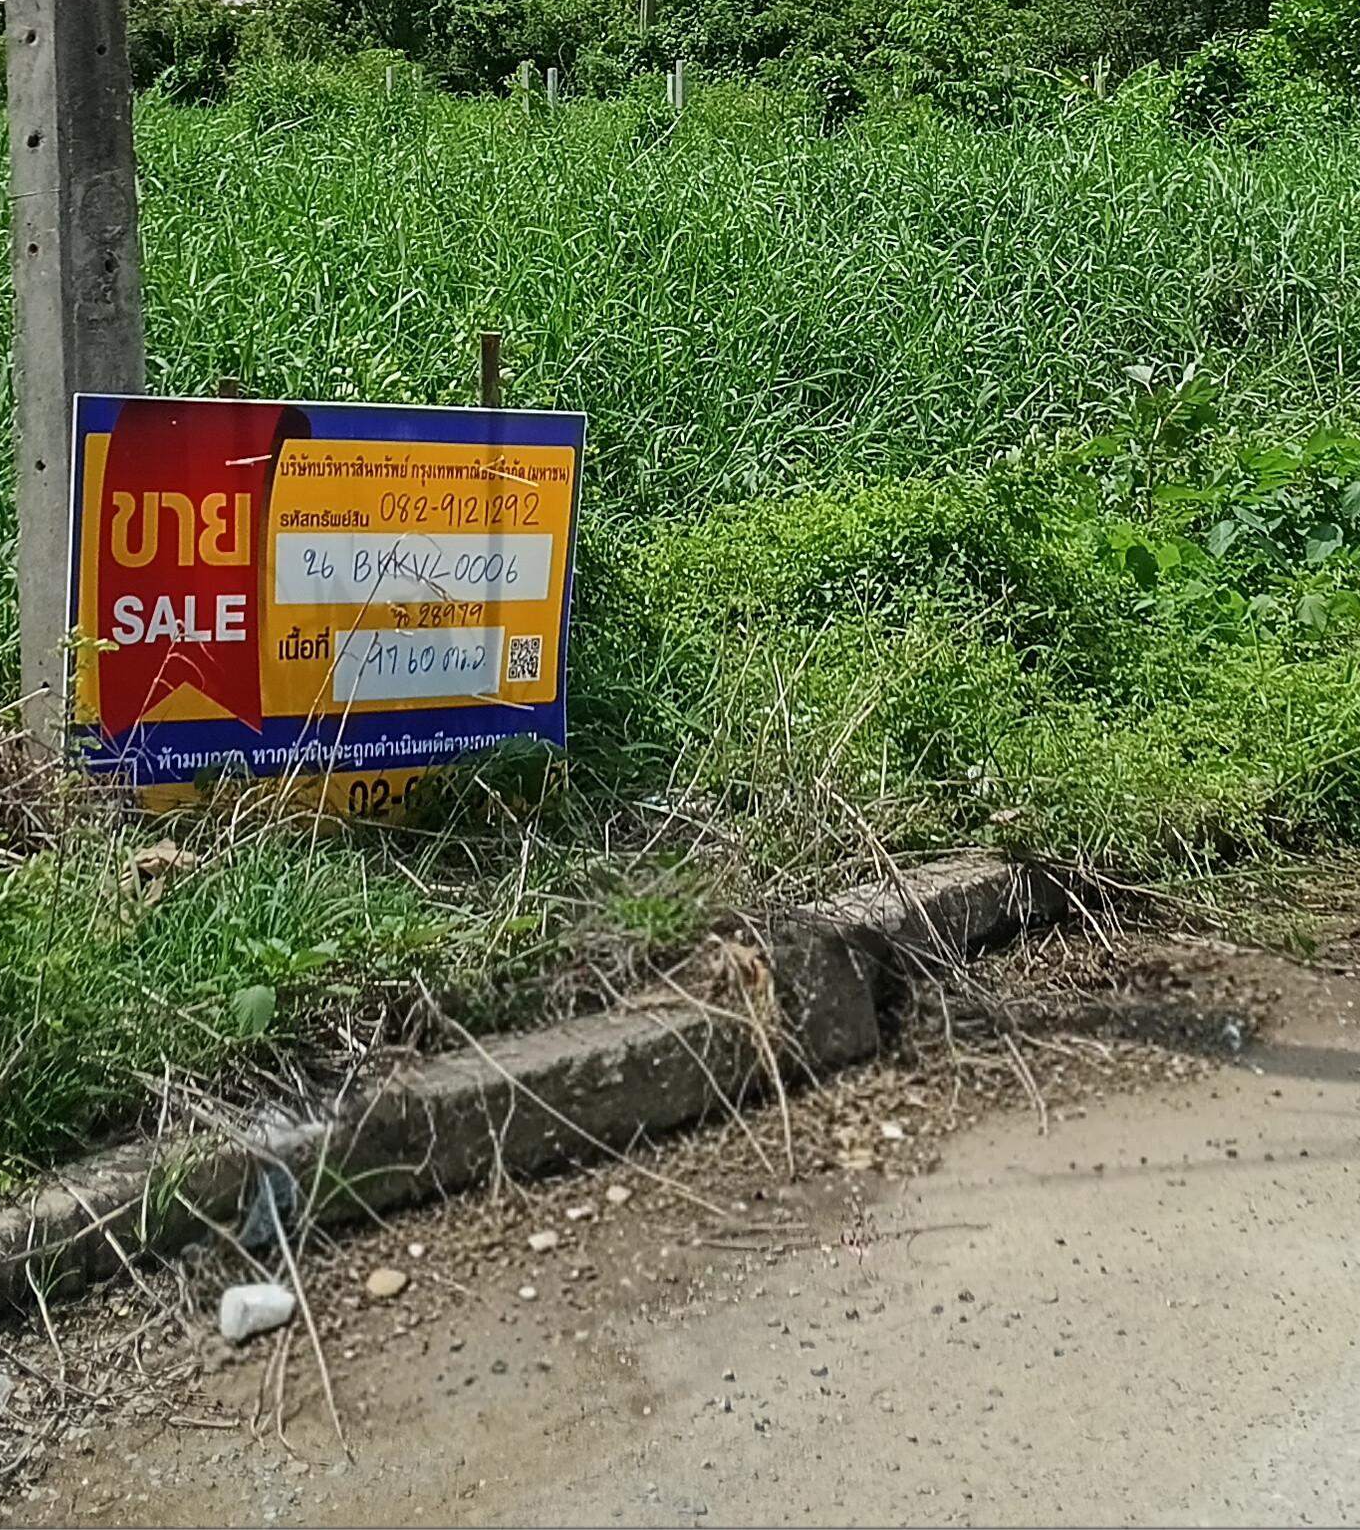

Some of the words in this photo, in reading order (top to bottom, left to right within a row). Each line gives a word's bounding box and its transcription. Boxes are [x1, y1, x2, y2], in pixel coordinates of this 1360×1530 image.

[280, 453, 410, 478] บริษัทบริหารสินทรัพย์
[528, 464, 570, 486] (มหาชน)
[280, 509, 370, 528] รหัสทรัพย์สิน
[380, 491, 540, 529] 082-9121292
[111, 491, 252, 568] ขาย
[303, 548, 334, 580] 26
[112, 594, 248, 645] SALE
[279, 625, 330, 661] เนื้อที่
